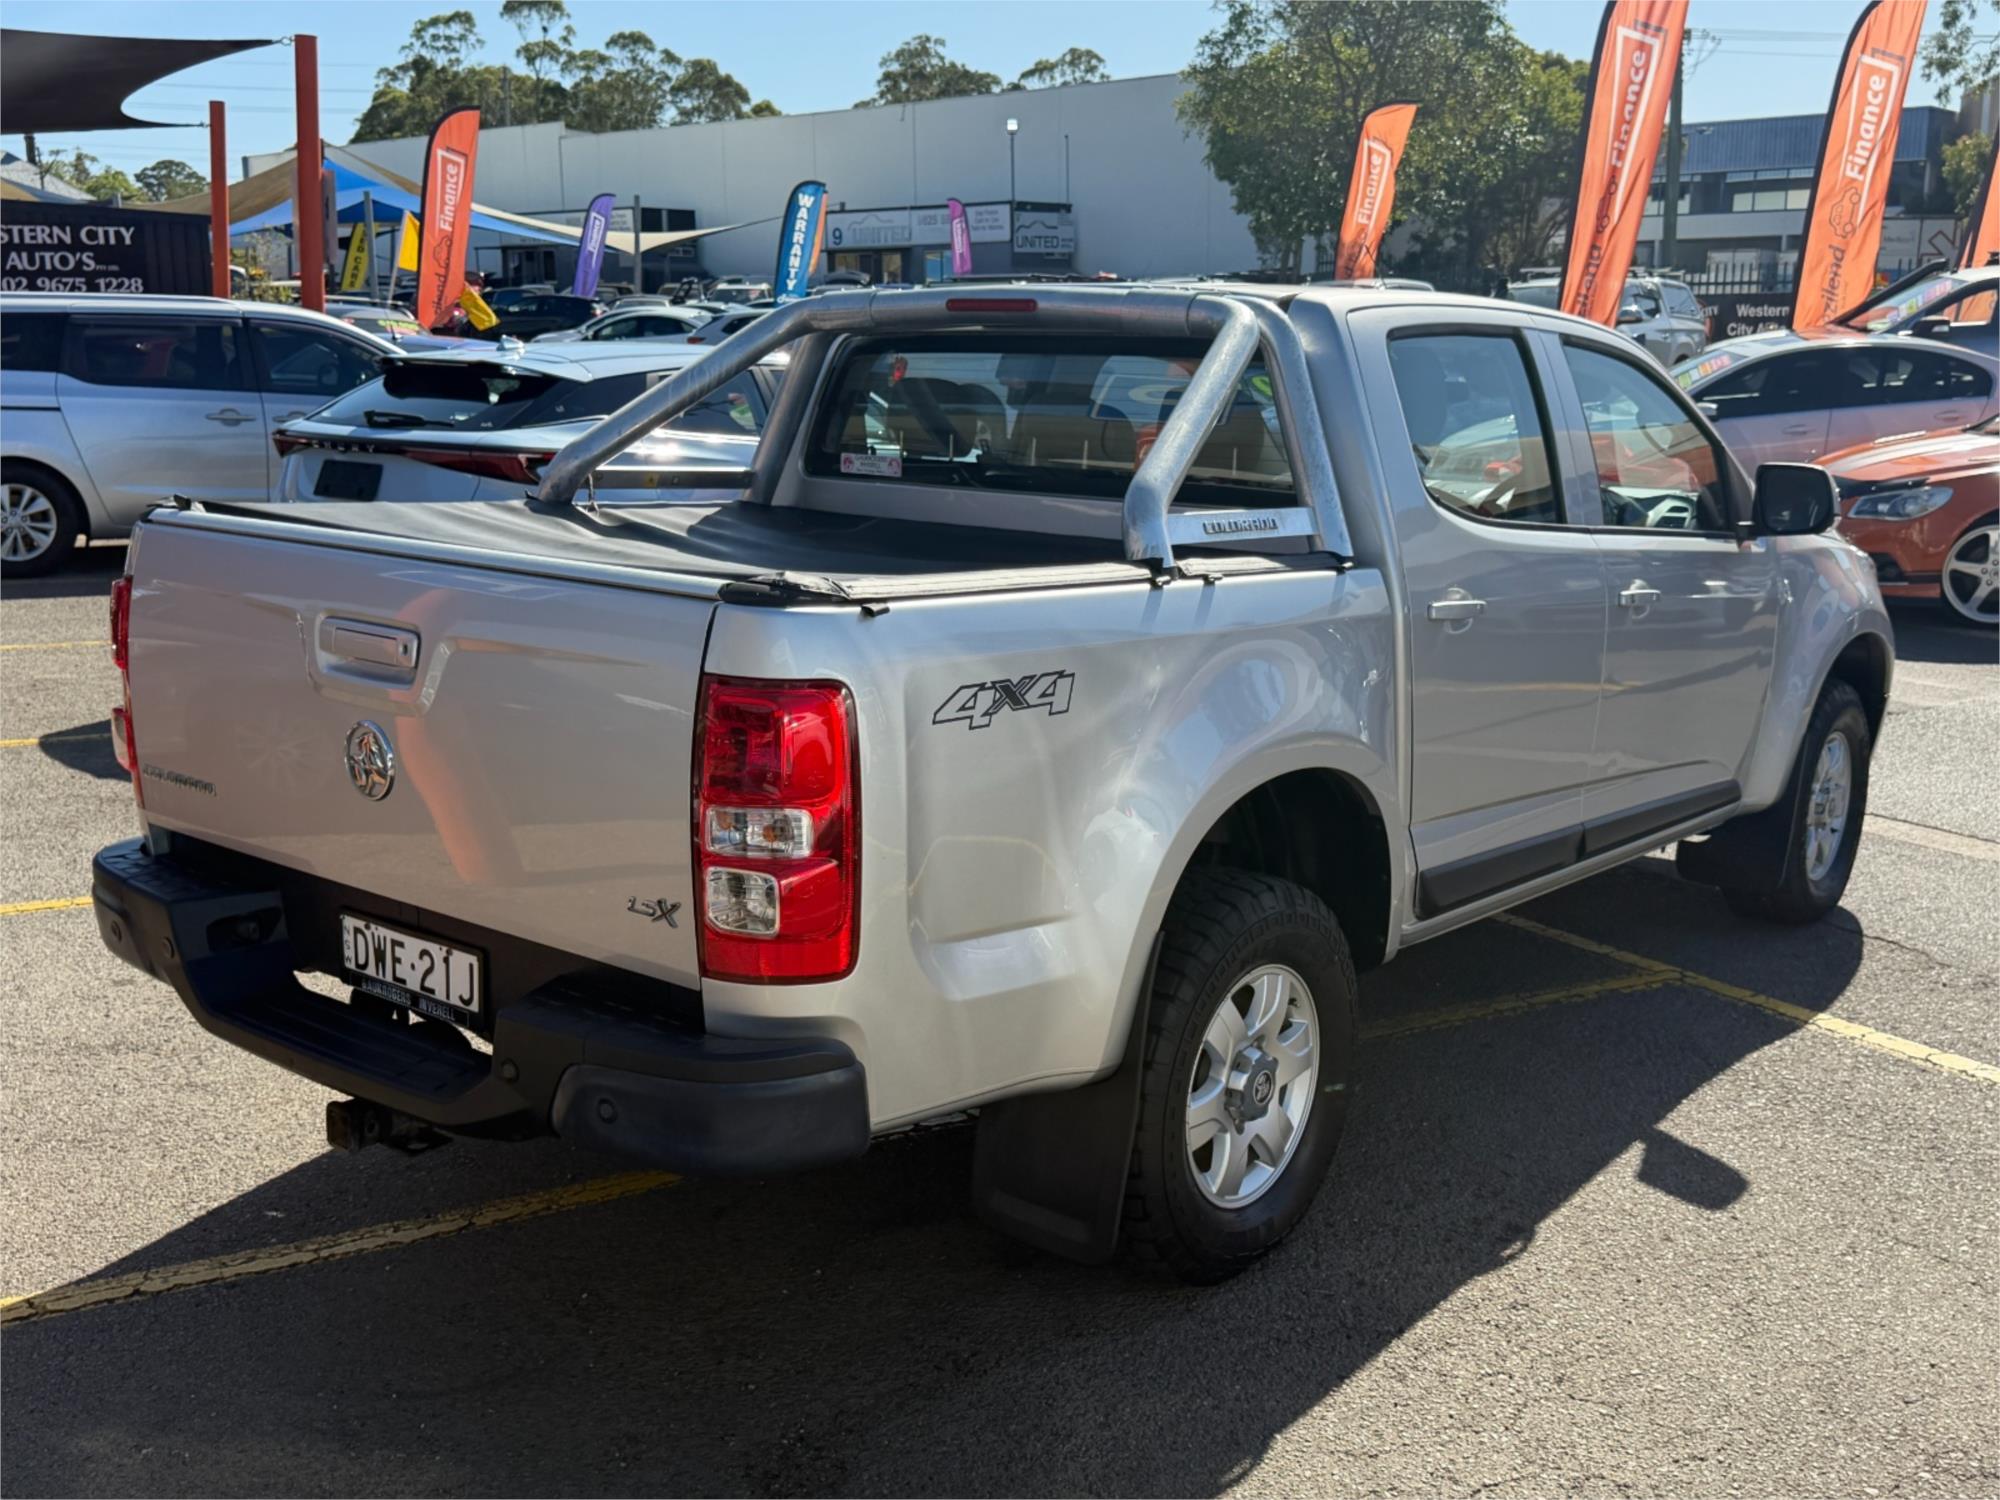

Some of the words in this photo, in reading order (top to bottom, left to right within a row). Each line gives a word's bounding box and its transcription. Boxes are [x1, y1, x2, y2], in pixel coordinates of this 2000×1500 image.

[1844, 74, 1888, 181] Finance
[439, 162, 460, 232] Finance
[1357, 153, 1384, 225] Finance
[79, 226, 136, 246] CITY
[786, 192, 815, 291] WARRANTY
[832, 222, 843, 246] 9
[1015, 235, 1059, 249] UNITED
[5, 251, 96, 272] AUTO'S
[1, 276, 29, 292] 02
[36, 276, 88, 293] 9675
[95, 277, 144, 293] 1228
[1736, 303, 1790, 318] Western
